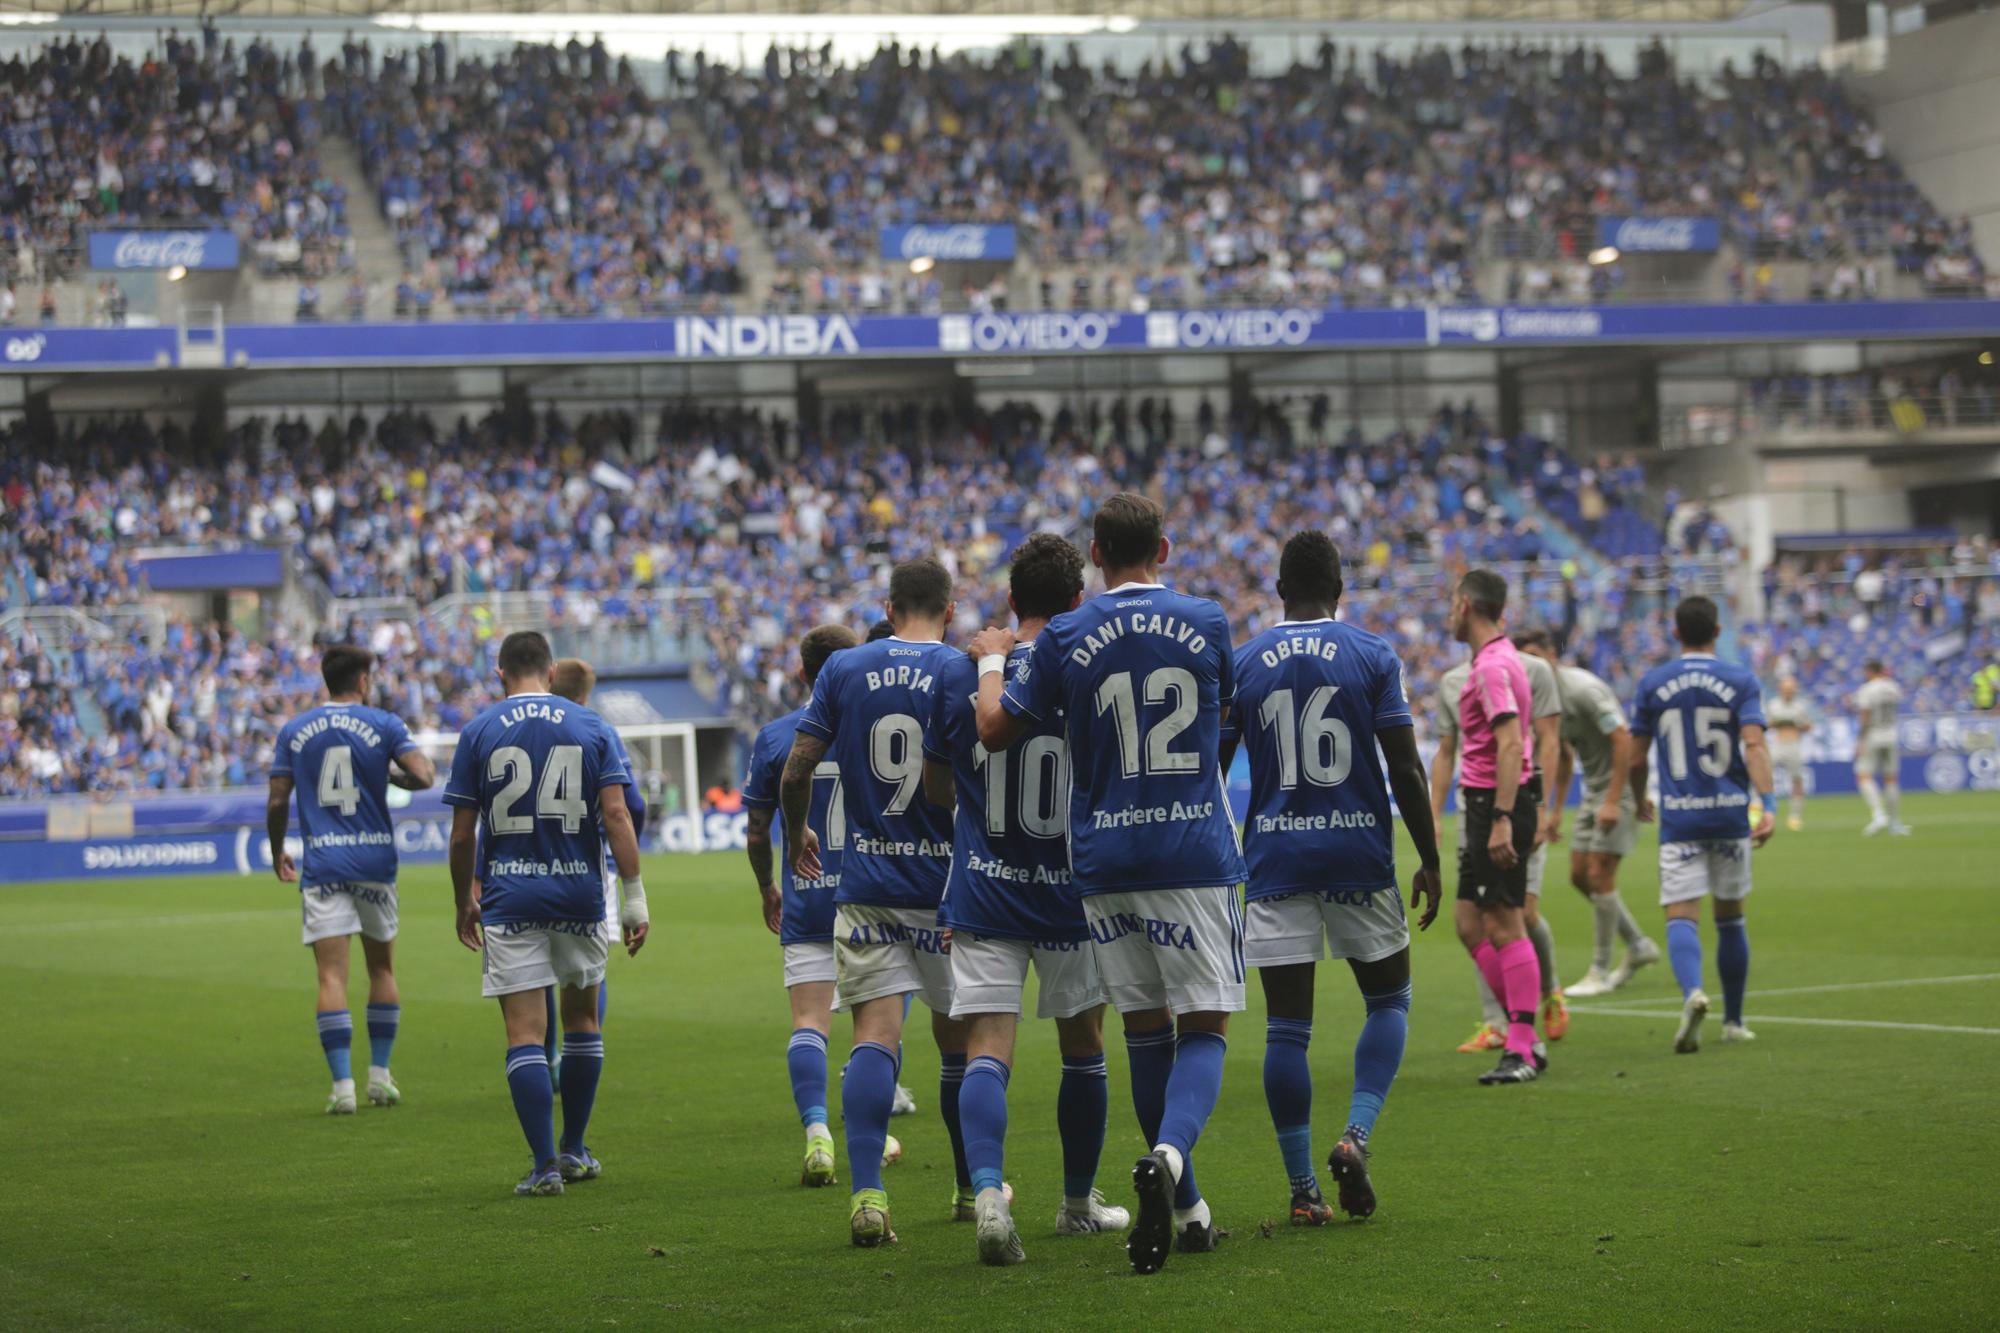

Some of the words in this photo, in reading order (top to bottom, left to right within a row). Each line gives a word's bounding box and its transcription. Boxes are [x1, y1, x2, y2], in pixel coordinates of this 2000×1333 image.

[674, 314, 860, 357] INDIBA
[973, 313, 1109, 352] OVIEDO
[1179, 308, 1312, 346] OVIEDO
[1072, 616, 1125, 668] DANI
[1131, 613, 1206, 655] CALVO
[1261, 637, 1338, 668] OBENG
[866, 666, 933, 693] BORJA
[290, 717, 328, 752] DAVID
[331, 714, 381, 748] COSTAS
[500, 703, 566, 728] LUCAS
[1094, 667, 1200, 779] 12
[1258, 686, 1352, 790] 16
[1659, 706, 1731, 781] 15
[318, 746, 360, 816] 4
[870, 713, 924, 816] 9
[487, 745, 588, 836] 24
[812, 761, 847, 850] 7
[972, 736, 1067, 839] 10
[1093, 804, 1167, 829] Tartiere
[1256, 811, 1326, 833] Tartiere
[1329, 809, 1376, 829] Auto
[83, 841, 217, 869] SOLUCIONES
[358, 830, 392, 845] Auto
[853, 832, 915, 856] Tatiere
[918, 838, 954, 857] Aut
[489, 859, 548, 877] Tartiere
[551, 858, 588, 875] Auto
[792, 872, 841, 891] Tartier
[966, 850, 1029, 883] artiere
[1032, 864, 1073, 885] Aut
